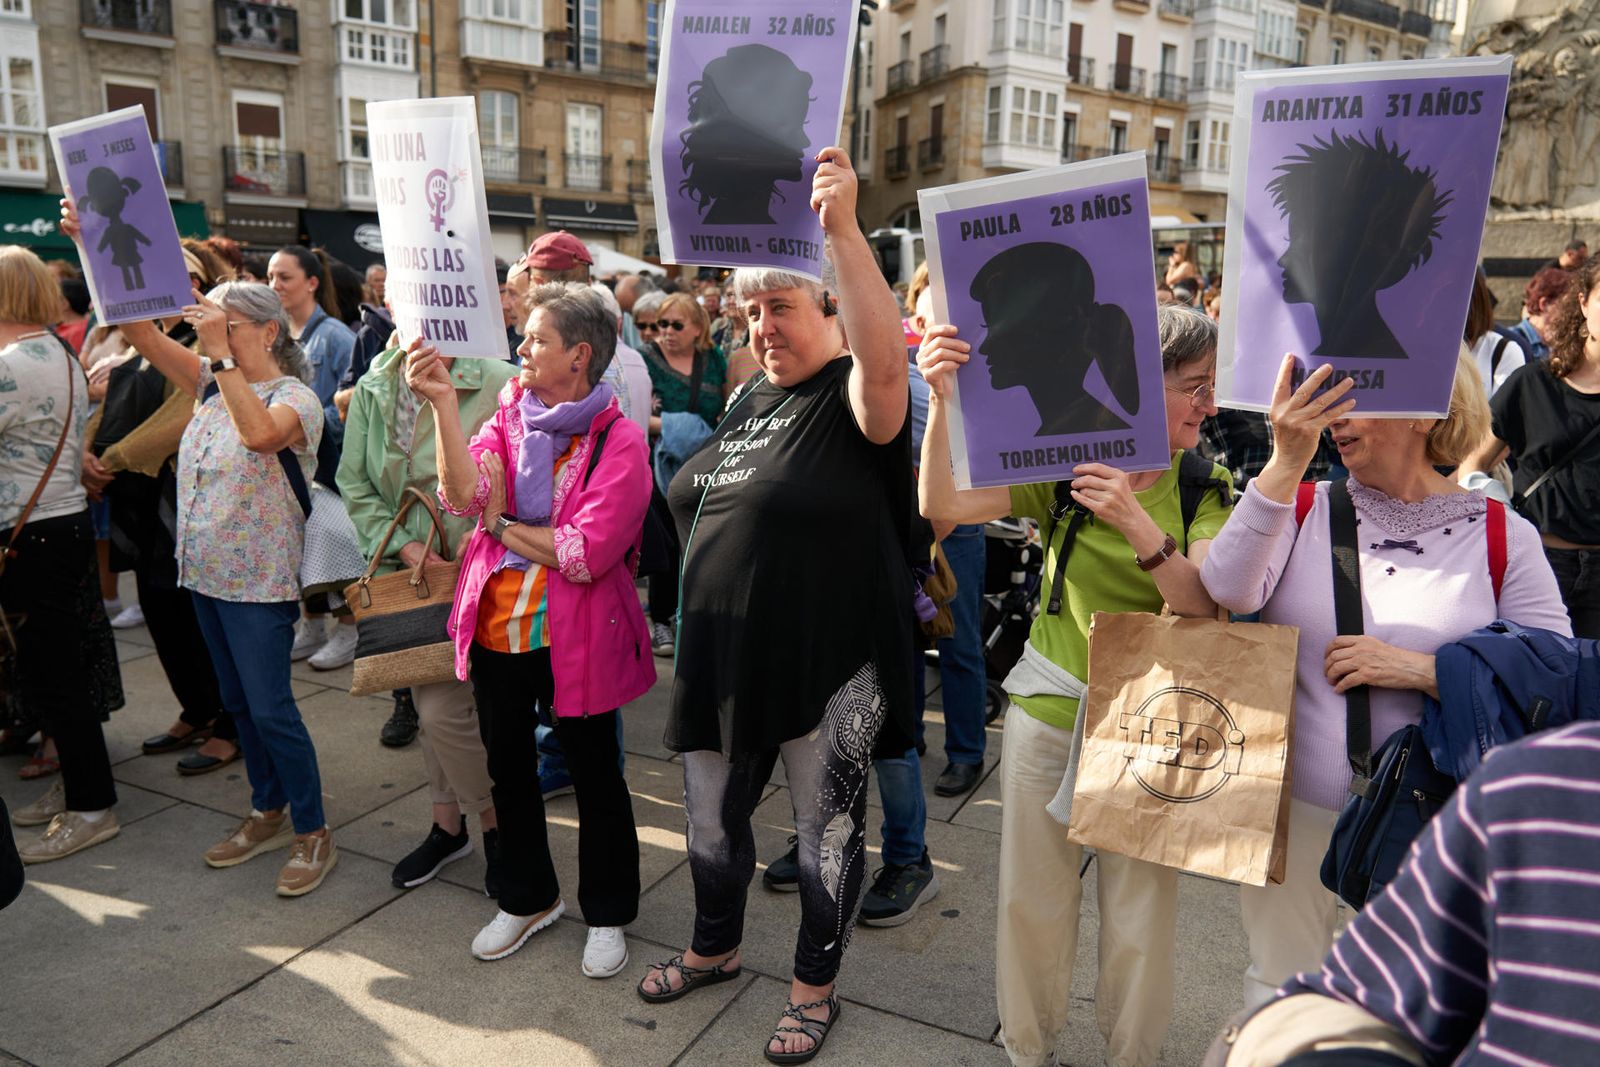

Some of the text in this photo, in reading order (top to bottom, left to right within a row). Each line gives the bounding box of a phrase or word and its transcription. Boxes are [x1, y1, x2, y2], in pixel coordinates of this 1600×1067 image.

[682, 13, 836, 37] MAIALEN 32 AÑOS
[1262, 86, 1484, 123] ARANTXA 31 AÑOS
[392, 131, 427, 163] UNA
[960, 193, 1133, 242] PAULA 28 AÑOS
[432, 247, 466, 273] LAS
[689, 235, 752, 254] VITORIA
[767, 237, 820, 262] GASTEIZ
[105, 294, 176, 317] FUERTEVENTURA
[718, 435, 772, 453] VERSION
[1000, 439, 1136, 470] TORREMOLINOS
[724, 455, 744, 468] OF
[692, 467, 757, 488] YOURSELF
